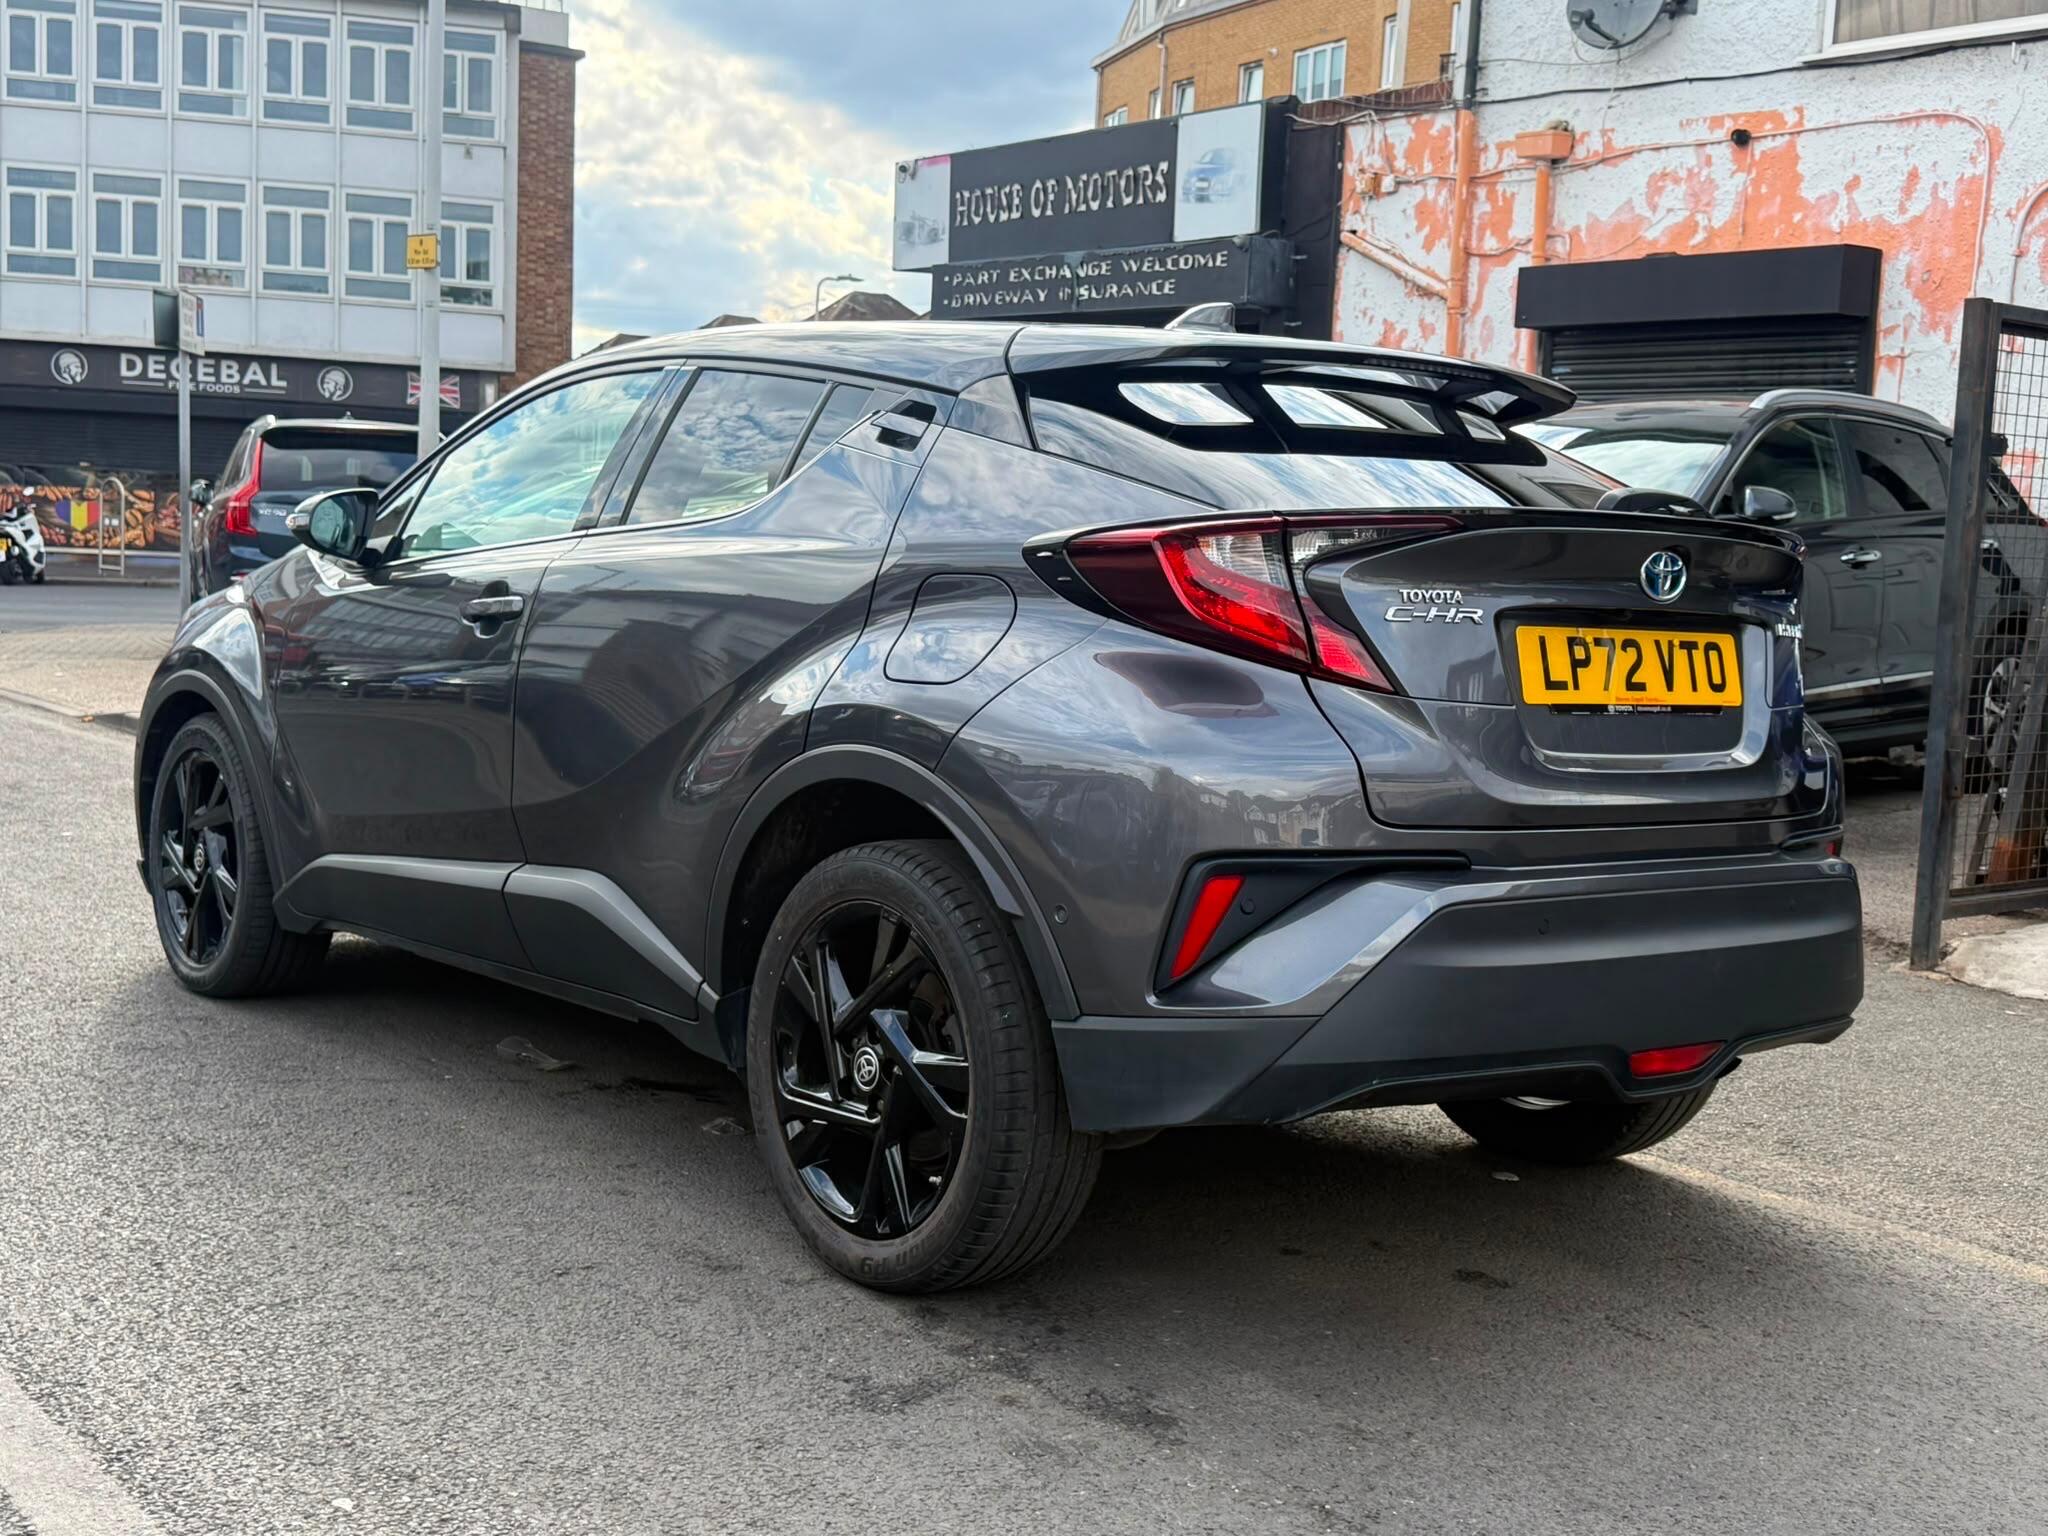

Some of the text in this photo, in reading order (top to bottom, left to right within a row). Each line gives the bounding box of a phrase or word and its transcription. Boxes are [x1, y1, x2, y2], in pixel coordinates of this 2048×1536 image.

[954, 160, 1169, 227] HOUSE OF MOTORS
[952, 250, 1229, 287] PART EXCHANGE WELCOME
[951, 278, 1177, 308] DRIVEWAY INSURANCE
[119, 352, 288, 388] DECEBAL
[167, 380, 241, 394] FIE FOODS
[1398, 588, 1464, 605] TOYOTA
[1383, 605, 1484, 625] C-HR
[1538, 634, 1727, 693] LP72 VTO
